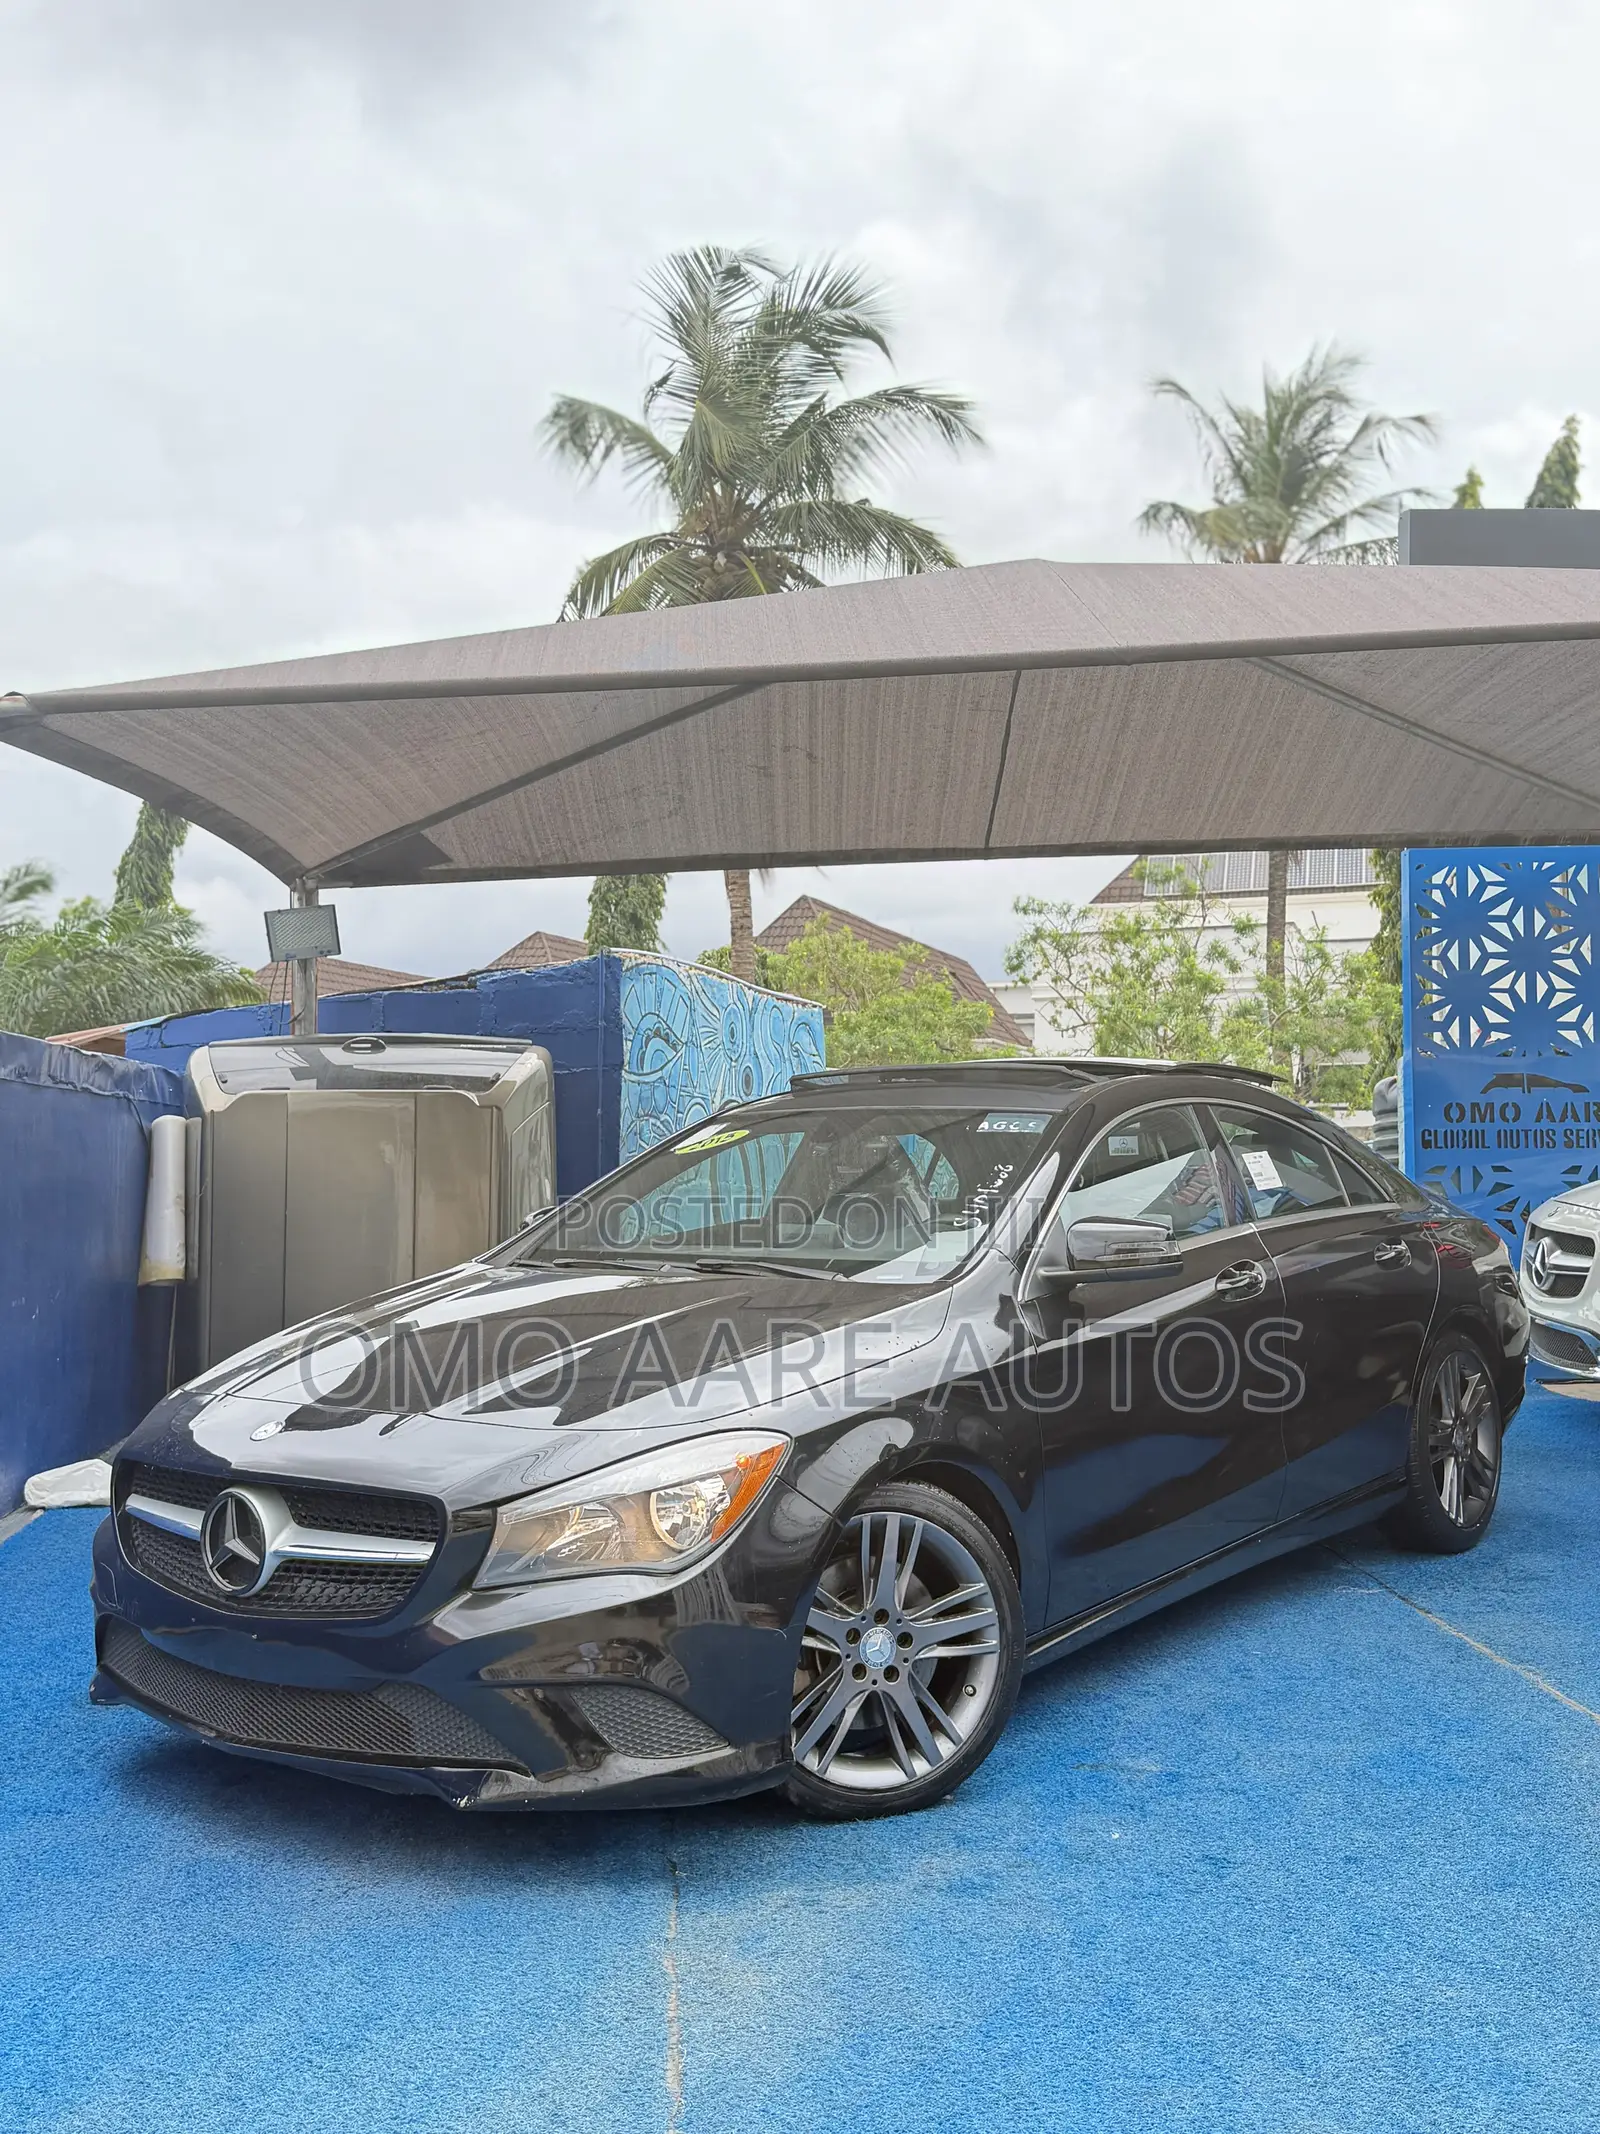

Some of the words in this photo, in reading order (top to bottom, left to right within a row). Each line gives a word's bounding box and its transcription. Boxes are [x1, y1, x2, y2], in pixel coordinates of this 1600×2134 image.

[1443, 1101, 1522, 1124] OMO
[1420, 1128, 1491, 1150] GLOBAL
[1496, 1128, 1557, 1150] AUTOS
[1563, 1128, 1600, 1150] SER
